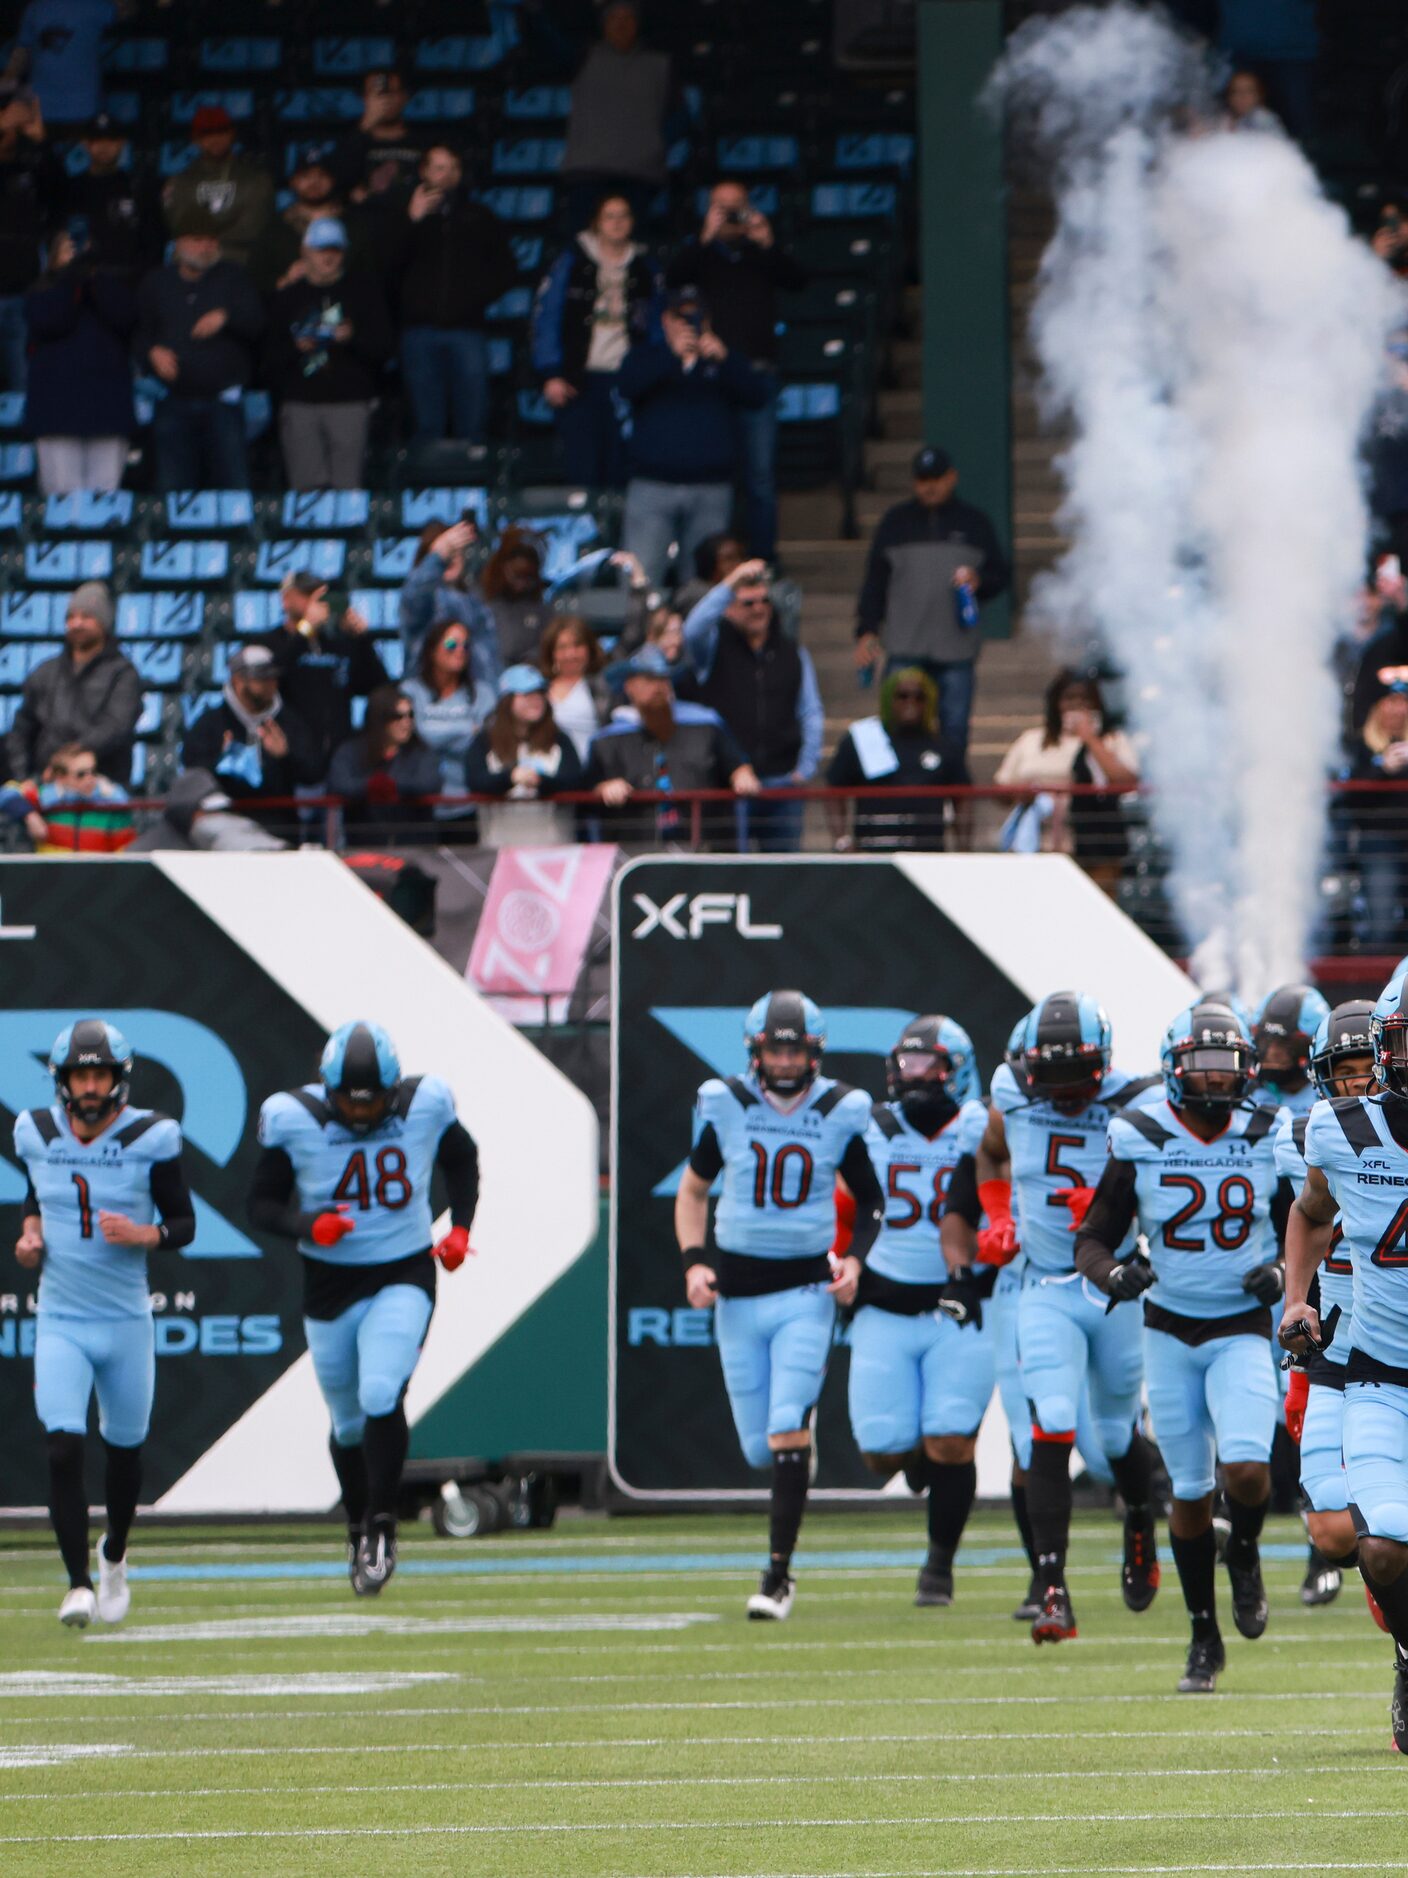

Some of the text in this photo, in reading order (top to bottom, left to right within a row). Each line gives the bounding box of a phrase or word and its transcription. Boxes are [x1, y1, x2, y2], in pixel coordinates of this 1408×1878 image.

[632, 893, 783, 940] XFL
[333, 1147, 412, 1211] 48
[750, 1140, 814, 1209] 10
[1045, 1131, 1087, 1206] 5
[1164, 1158, 1253, 1168] RENEGADES
[1363, 1160, 1391, 1170] XFL
[71, 1171, 93, 1238] 1
[1160, 1173, 1256, 1251] 28
